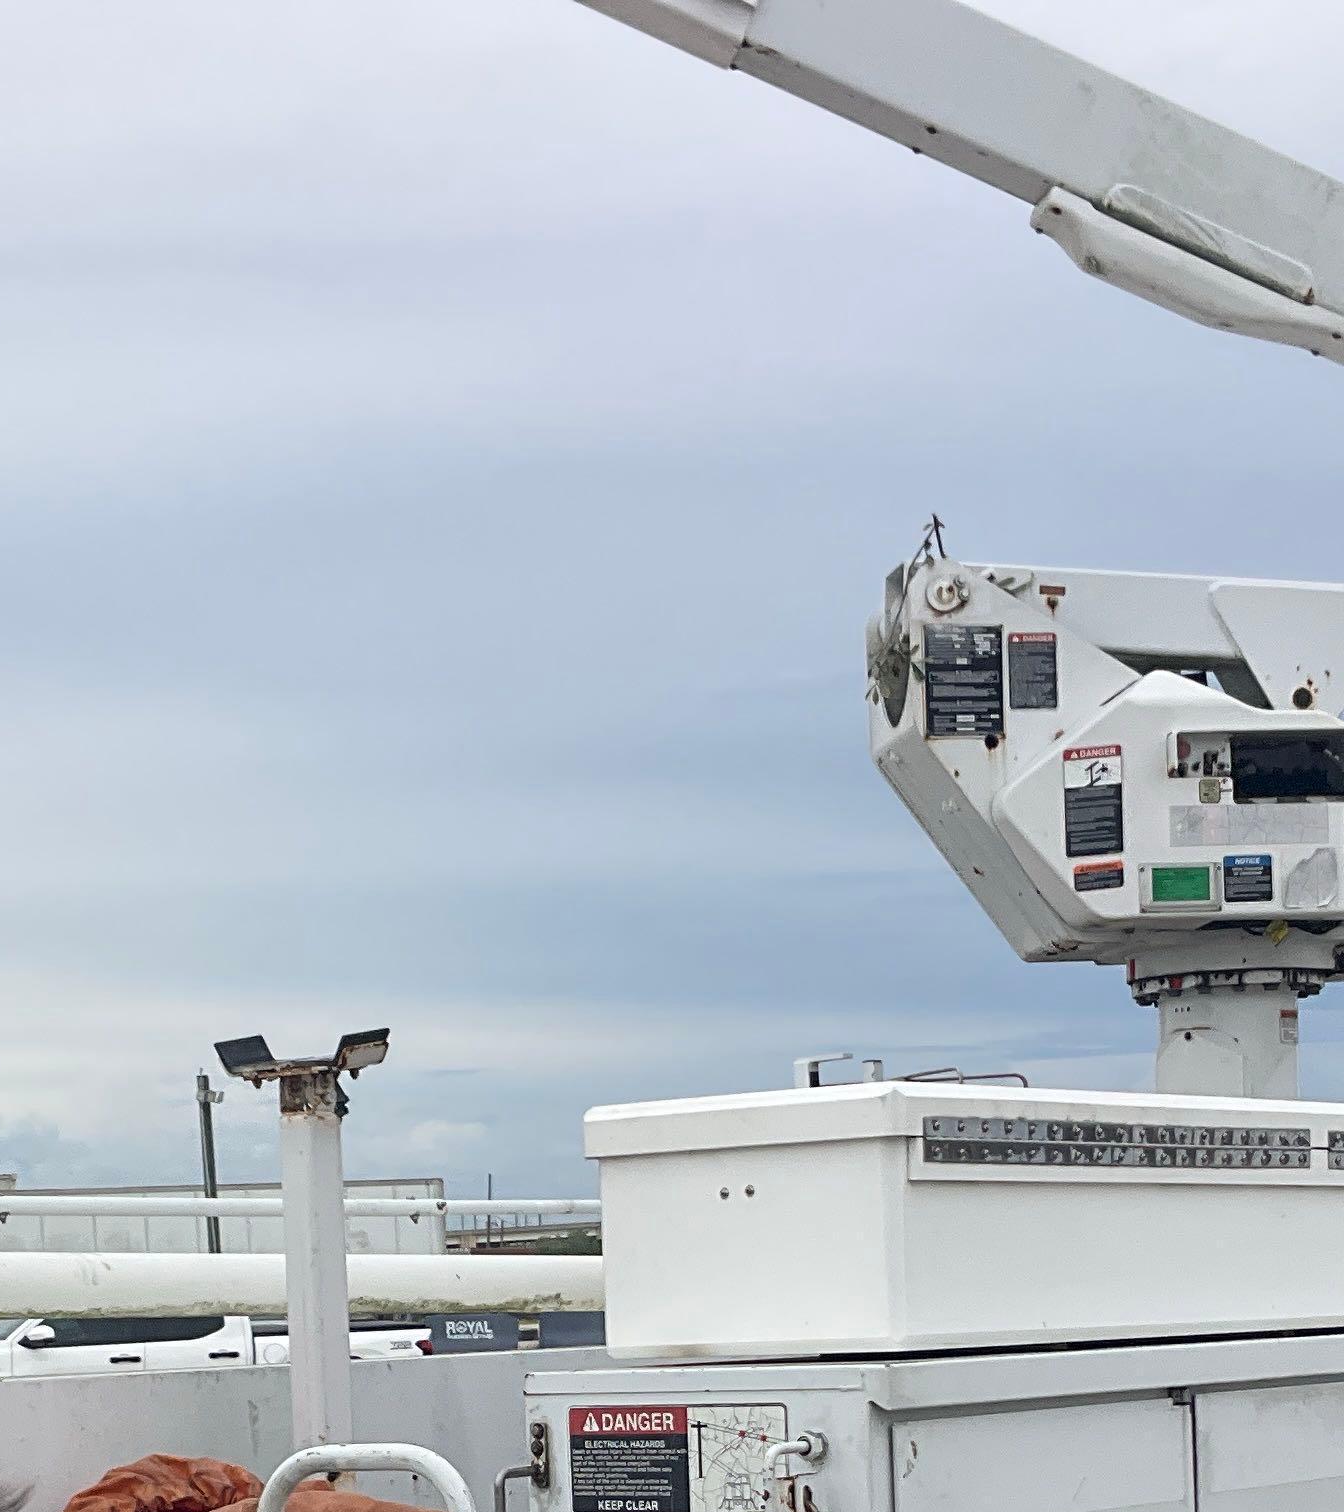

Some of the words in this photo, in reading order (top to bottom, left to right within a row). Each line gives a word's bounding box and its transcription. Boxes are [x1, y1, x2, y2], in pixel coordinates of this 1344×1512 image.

[1079, 747, 1116, 758] DANGER
[445, 1320, 493, 1334] ROYAL
[601, 1412, 674, 1431] DANGER
[584, 1440, 629, 1448] ELECTRICAL
[630, 1440, 666, 1448] HAZARDS
[597, 1500, 624, 1511] KEEP
[625, 1500, 659, 1511] CLEAR
